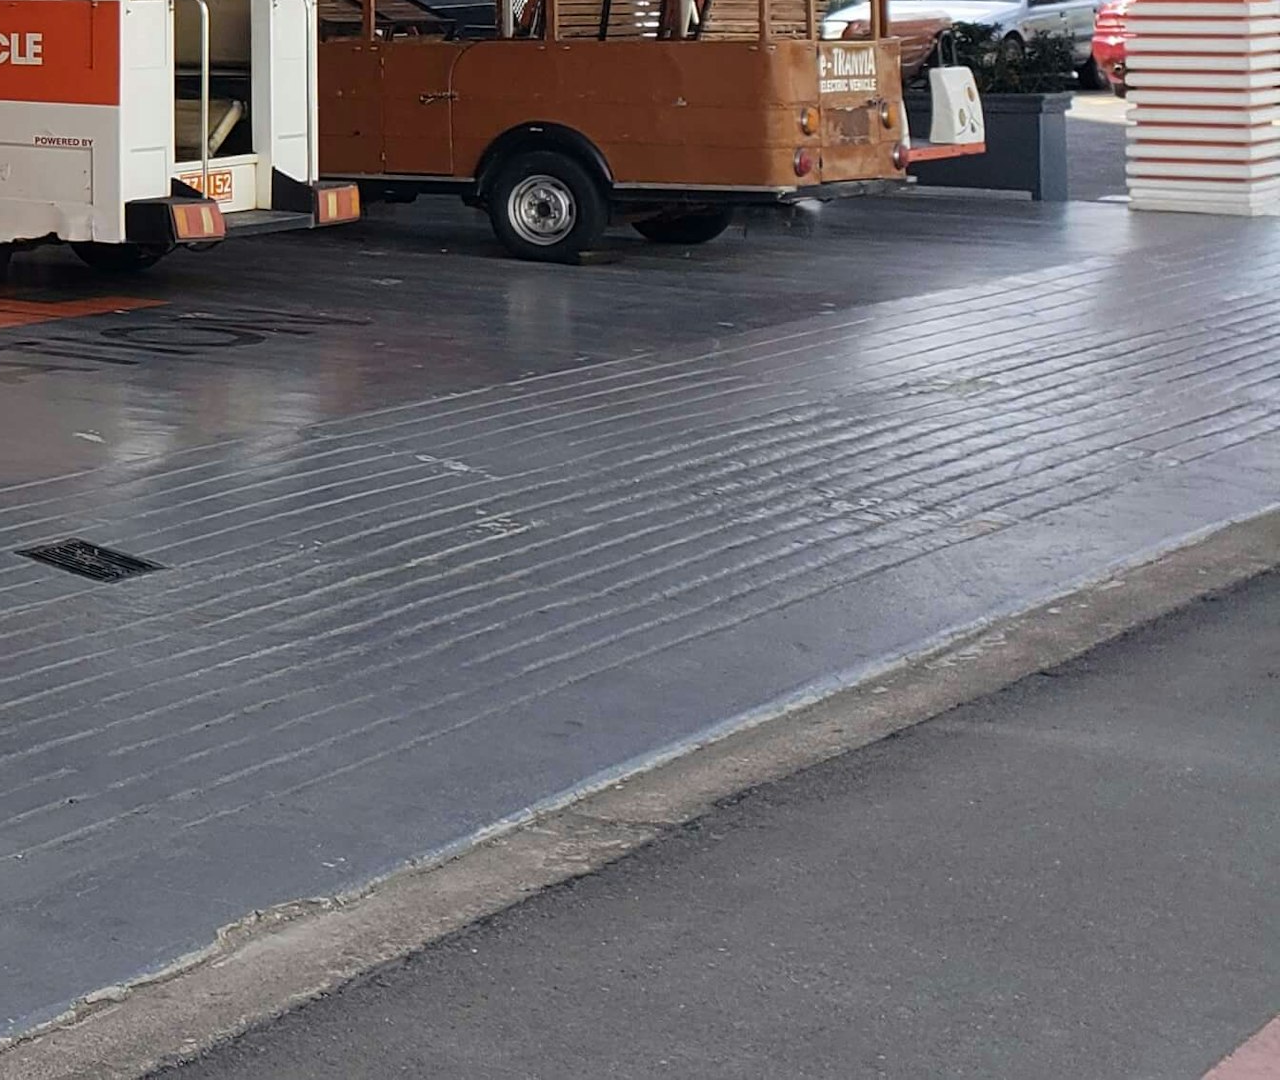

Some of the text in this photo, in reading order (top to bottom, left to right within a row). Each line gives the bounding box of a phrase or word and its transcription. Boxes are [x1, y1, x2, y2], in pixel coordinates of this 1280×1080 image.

[34, 136, 94, 147] POWERED BY
[210, 174, 231, 195] 152
